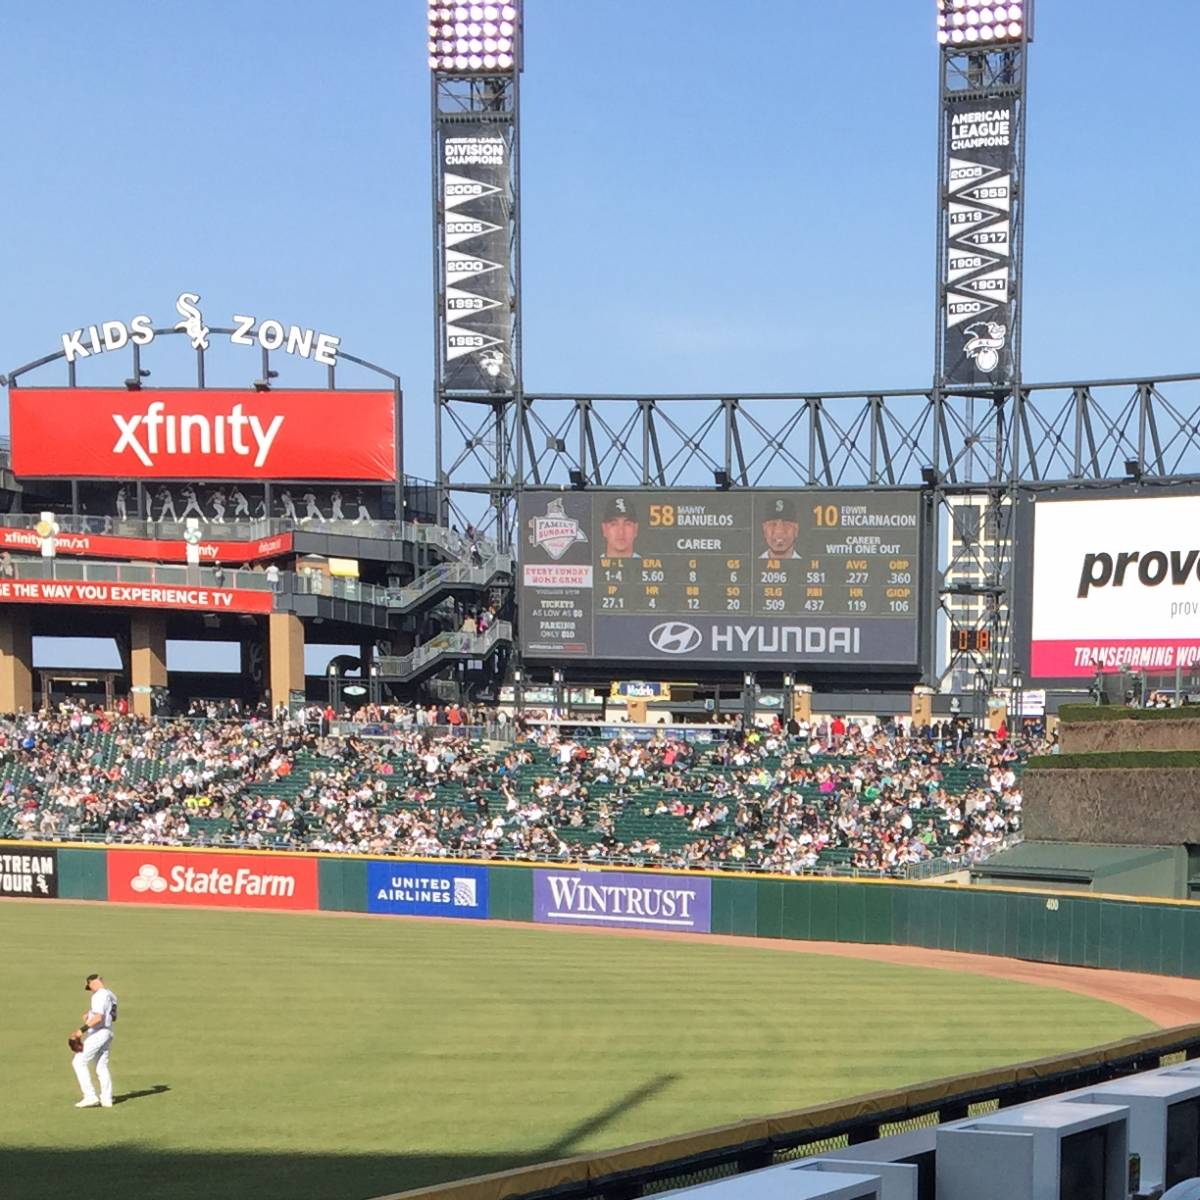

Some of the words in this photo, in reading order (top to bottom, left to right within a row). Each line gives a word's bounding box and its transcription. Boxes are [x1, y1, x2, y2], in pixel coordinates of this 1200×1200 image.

[952, 109, 1009, 125] AMERICAN
[952, 122, 1009, 140] LEAGUE
[952, 136, 1009, 150] CHAMPIONS
[445, 145, 503, 156] DIVISION
[446, 156, 503, 164] CHAMPIONS
[973, 188, 1006, 198] 1959
[973, 233, 1006, 243] 1917
[448, 262, 483, 272] 2000
[62, 316, 154, 362] KIDS
[230, 315, 340, 366] ZONE
[112, 402, 284, 467] xfinity
[650, 505, 674, 526] 58
[677, 514, 734, 526] BANUELOS
[813, 505, 838, 526] 10
[841, 515, 916, 526] ENCARNACION
[677, 539, 721, 550] CAREER
[846, 536, 881, 545] CAREER
[826, 545, 852, 554] WITH
[855, 544, 877, 553] ONE
[880, 544, 900, 553] OUT
[605, 571, 622, 581] 1-4
[642, 571, 664, 582] 5.60
[761, 572, 787, 583] 2096
[807, 572, 825, 583] 581
[846, 572, 868, 583] .277
[888, 573, 911, 584] .360
[12, 584, 39, 597] THE
[42, 584, 73, 599] WAY
[76, 586, 108, 599] YOU
[111, 588, 208, 605] EXPERIENCE
[212, 592, 232, 606] TV
[602, 598, 624, 608] 27.1
[804, 600, 824, 611] 437
[848, 601, 867, 611] 119
[889, 601, 909, 611] 106
[711, 626, 860, 653] HYUNDAI
[392, 877, 450, 890] UNITED
[378, 889, 451, 903] AIRLINES
[547, 876, 696, 918] WINTRUST
